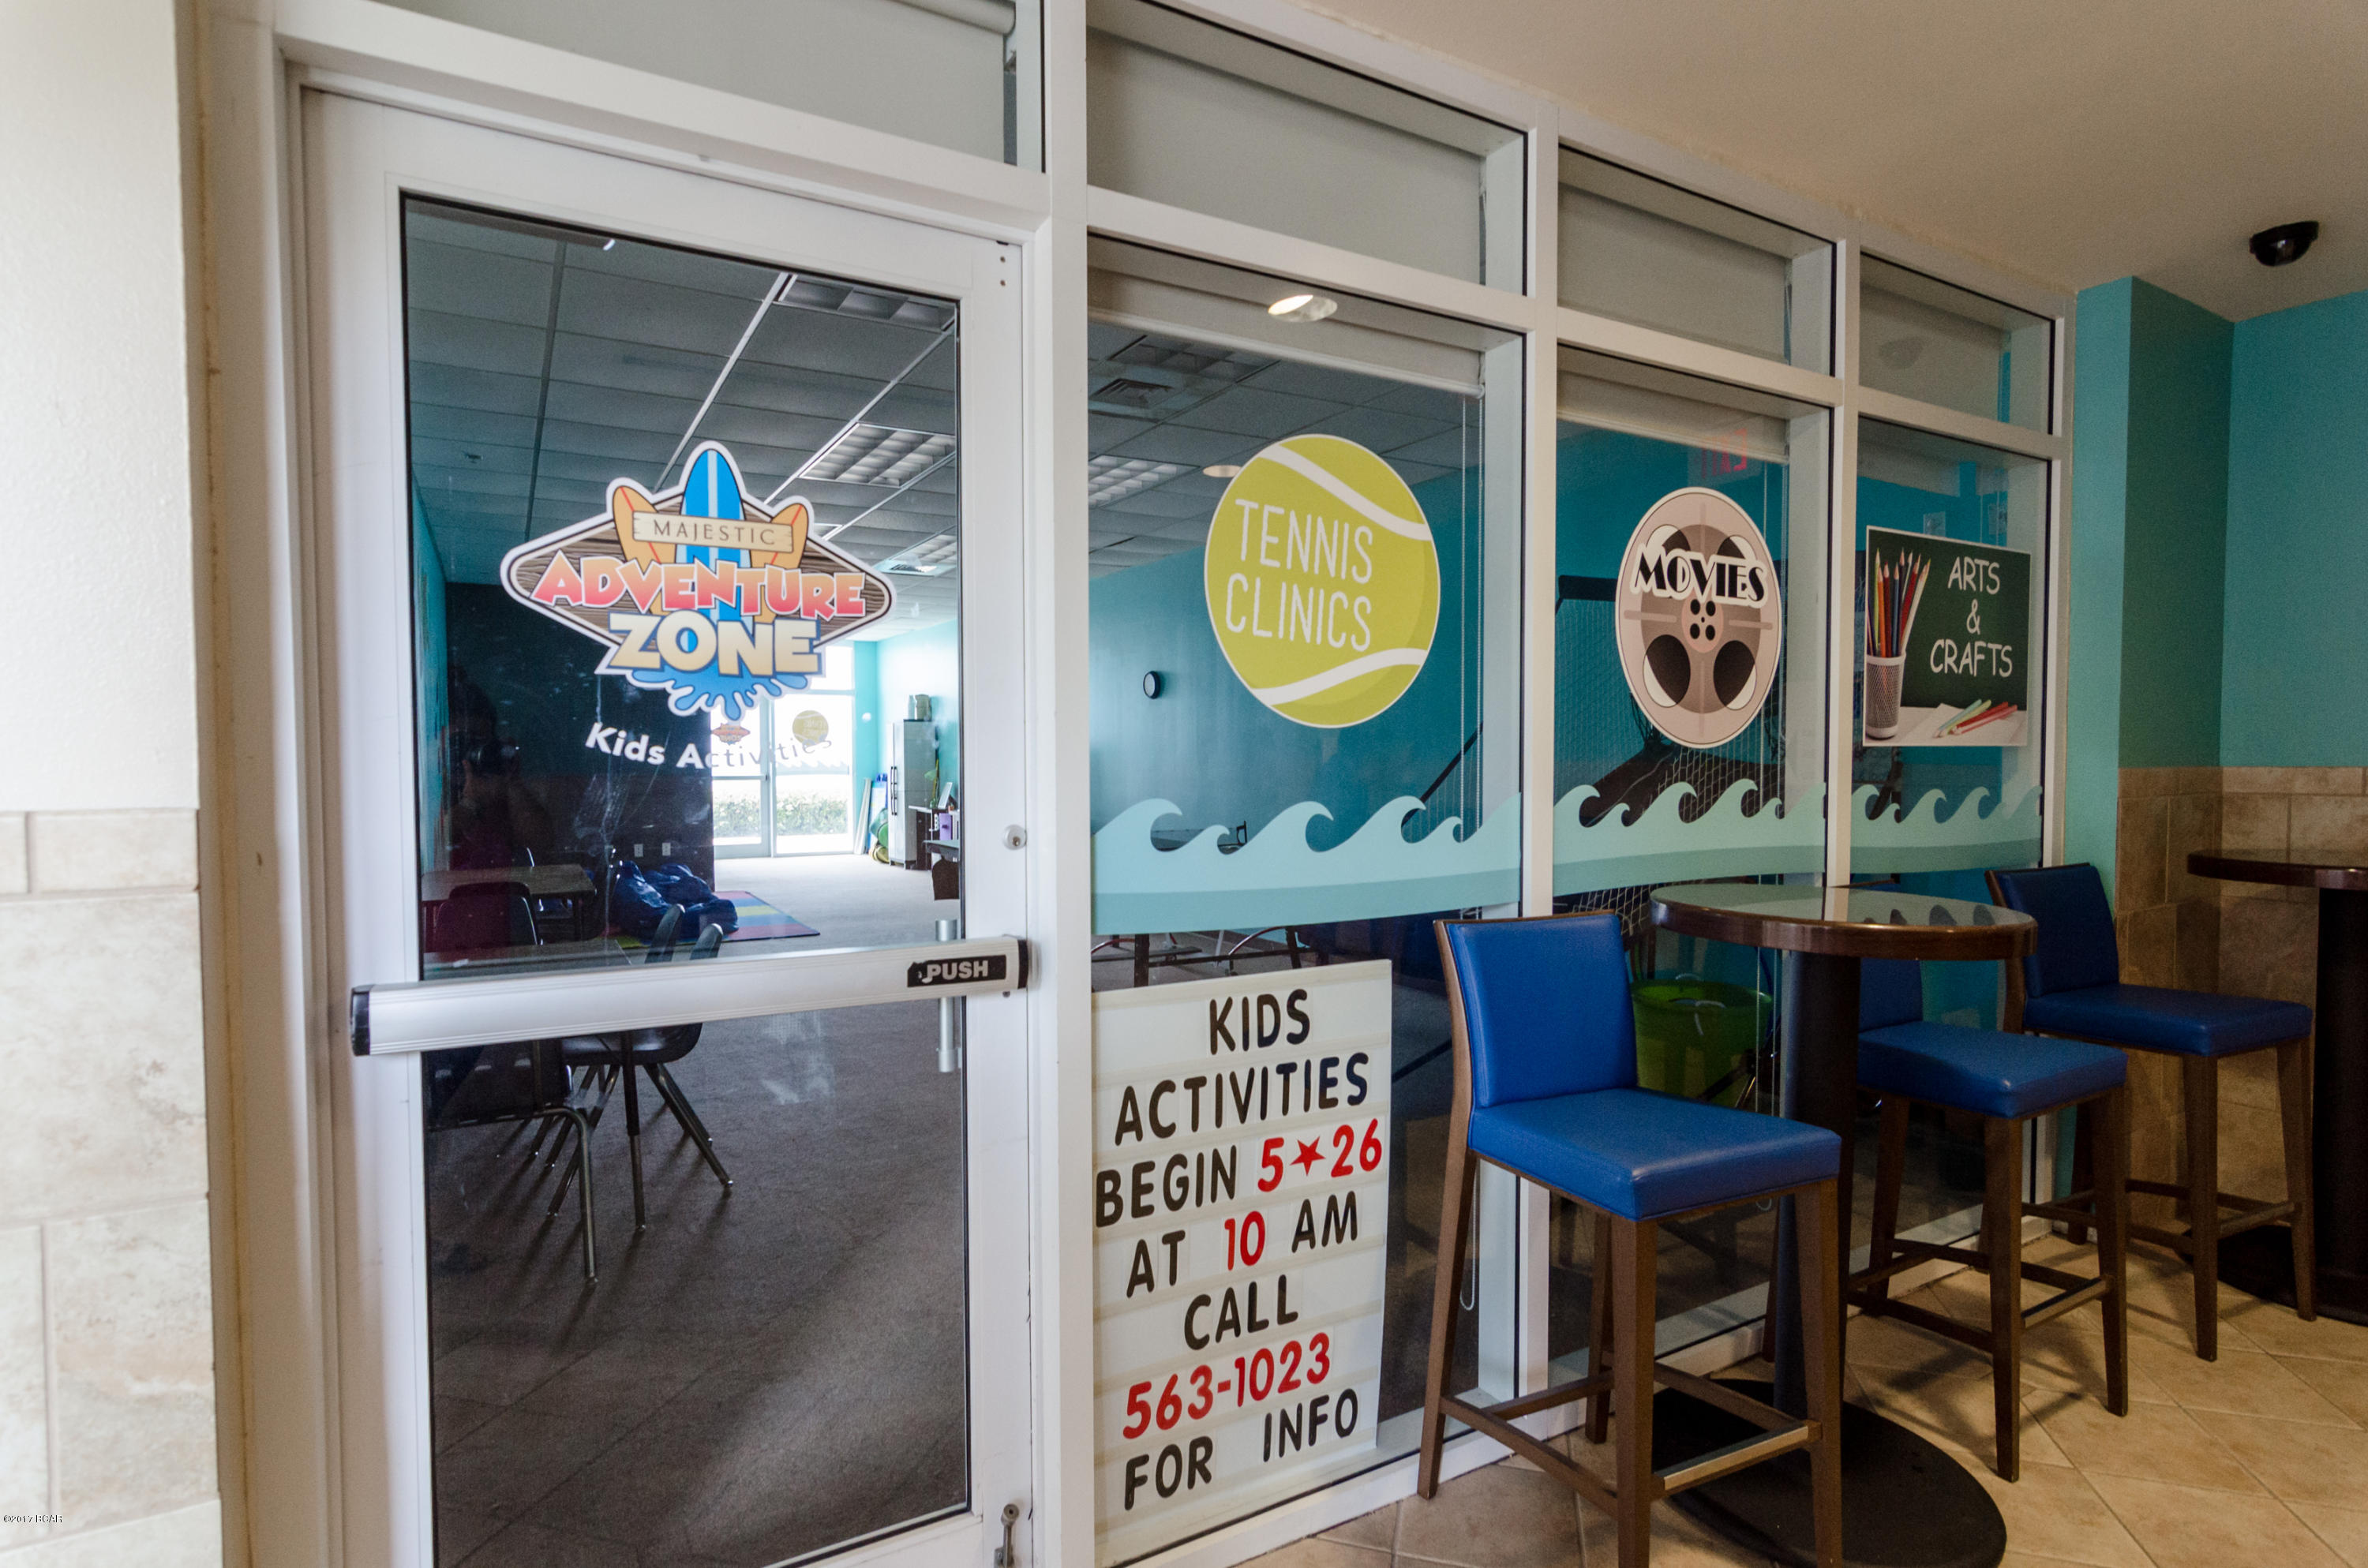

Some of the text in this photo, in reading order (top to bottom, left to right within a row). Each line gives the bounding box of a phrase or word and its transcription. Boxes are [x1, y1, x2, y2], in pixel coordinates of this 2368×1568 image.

[652, 518, 777, 546] MAJESTIC
[1235, 498, 1373, 584] TENNIS
[529, 549, 867, 621] ADVENTURE
[1635, 552, 1765, 602] MOVIES
[1947, 556, 2001, 595] ARTS
[608, 610, 822, 679] ZONE
[1225, 573, 1372, 652] CLINICS
[1966, 598, 1980, 635] &
[1929, 638, 2013, 677] CRAFTS
[585, 722, 666, 766] Kids
[920, 960, 988, 984] PUSH
[1209, 989, 1310, 1055] KIDS
[1115, 1052, 1369, 1146] ACTIVITIES
[1096, 1144, 1237, 1228] BEGIN
[1126, 1190, 1358, 1299] AT 10 AM
[1184, 1274, 1298, 1351] CALL
[1122, 1332, 1331, 1439] 563-1023
[1124, 1388, 1358, 1511] FOR INFO
